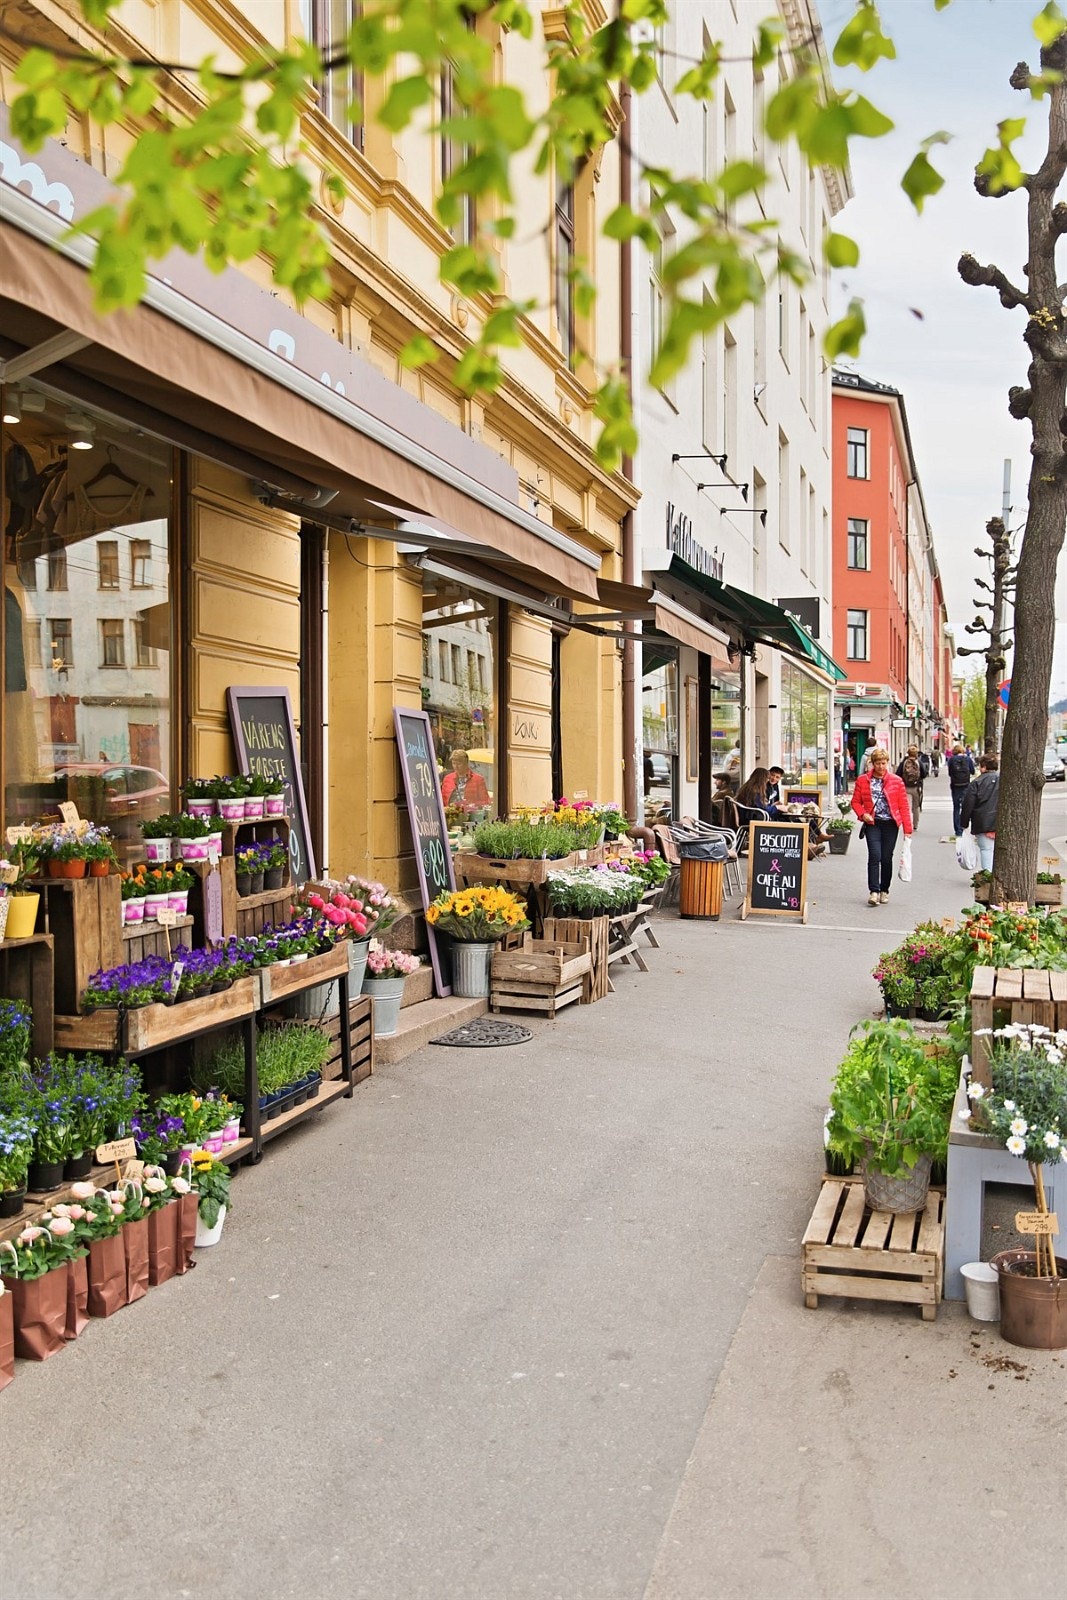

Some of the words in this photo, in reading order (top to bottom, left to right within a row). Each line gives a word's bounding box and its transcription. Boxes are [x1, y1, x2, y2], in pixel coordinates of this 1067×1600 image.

[242, 716, 285, 750] VÅRENS
[249, 756, 288, 779] FØRSTE
[759, 834, 799, 848] BISCOTTI
[756, 872, 780, 888] CAFÉ
[781, 875, 796, 889] AU
[765, 886, 788, 900] LAIT
